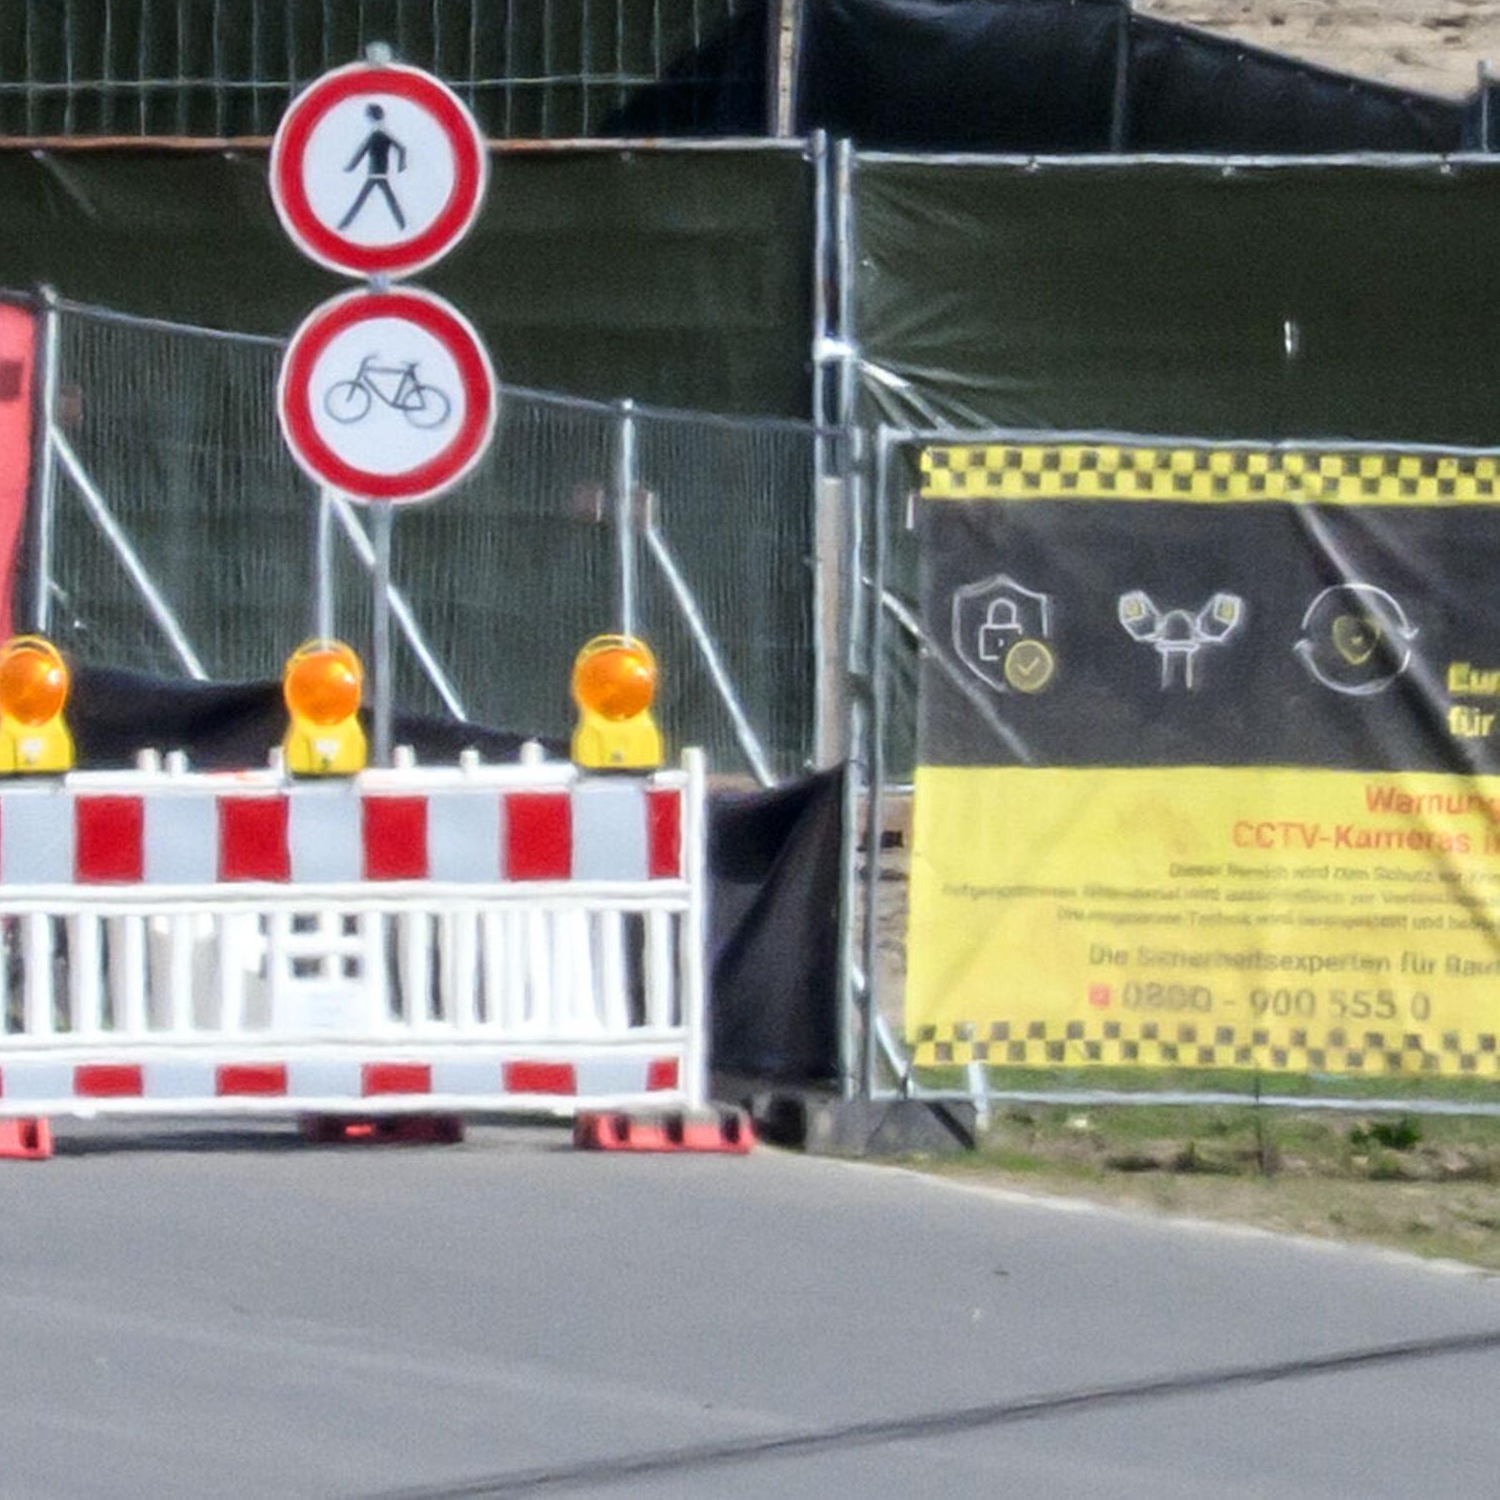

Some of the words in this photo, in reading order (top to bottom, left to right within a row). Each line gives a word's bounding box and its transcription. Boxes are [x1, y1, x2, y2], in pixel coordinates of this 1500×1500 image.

[1449, 705, 1495, 737] für
[1233, 821, 1470, 853] CCTV-Kameras
[1090, 943, 1128, 965] Die
[1402, 951, 1436, 974] für
[1250, 988, 1317, 1018] 900
[1331, 989, 1396, 1019] 555
[1411, 991, 1431, 1021] 0
